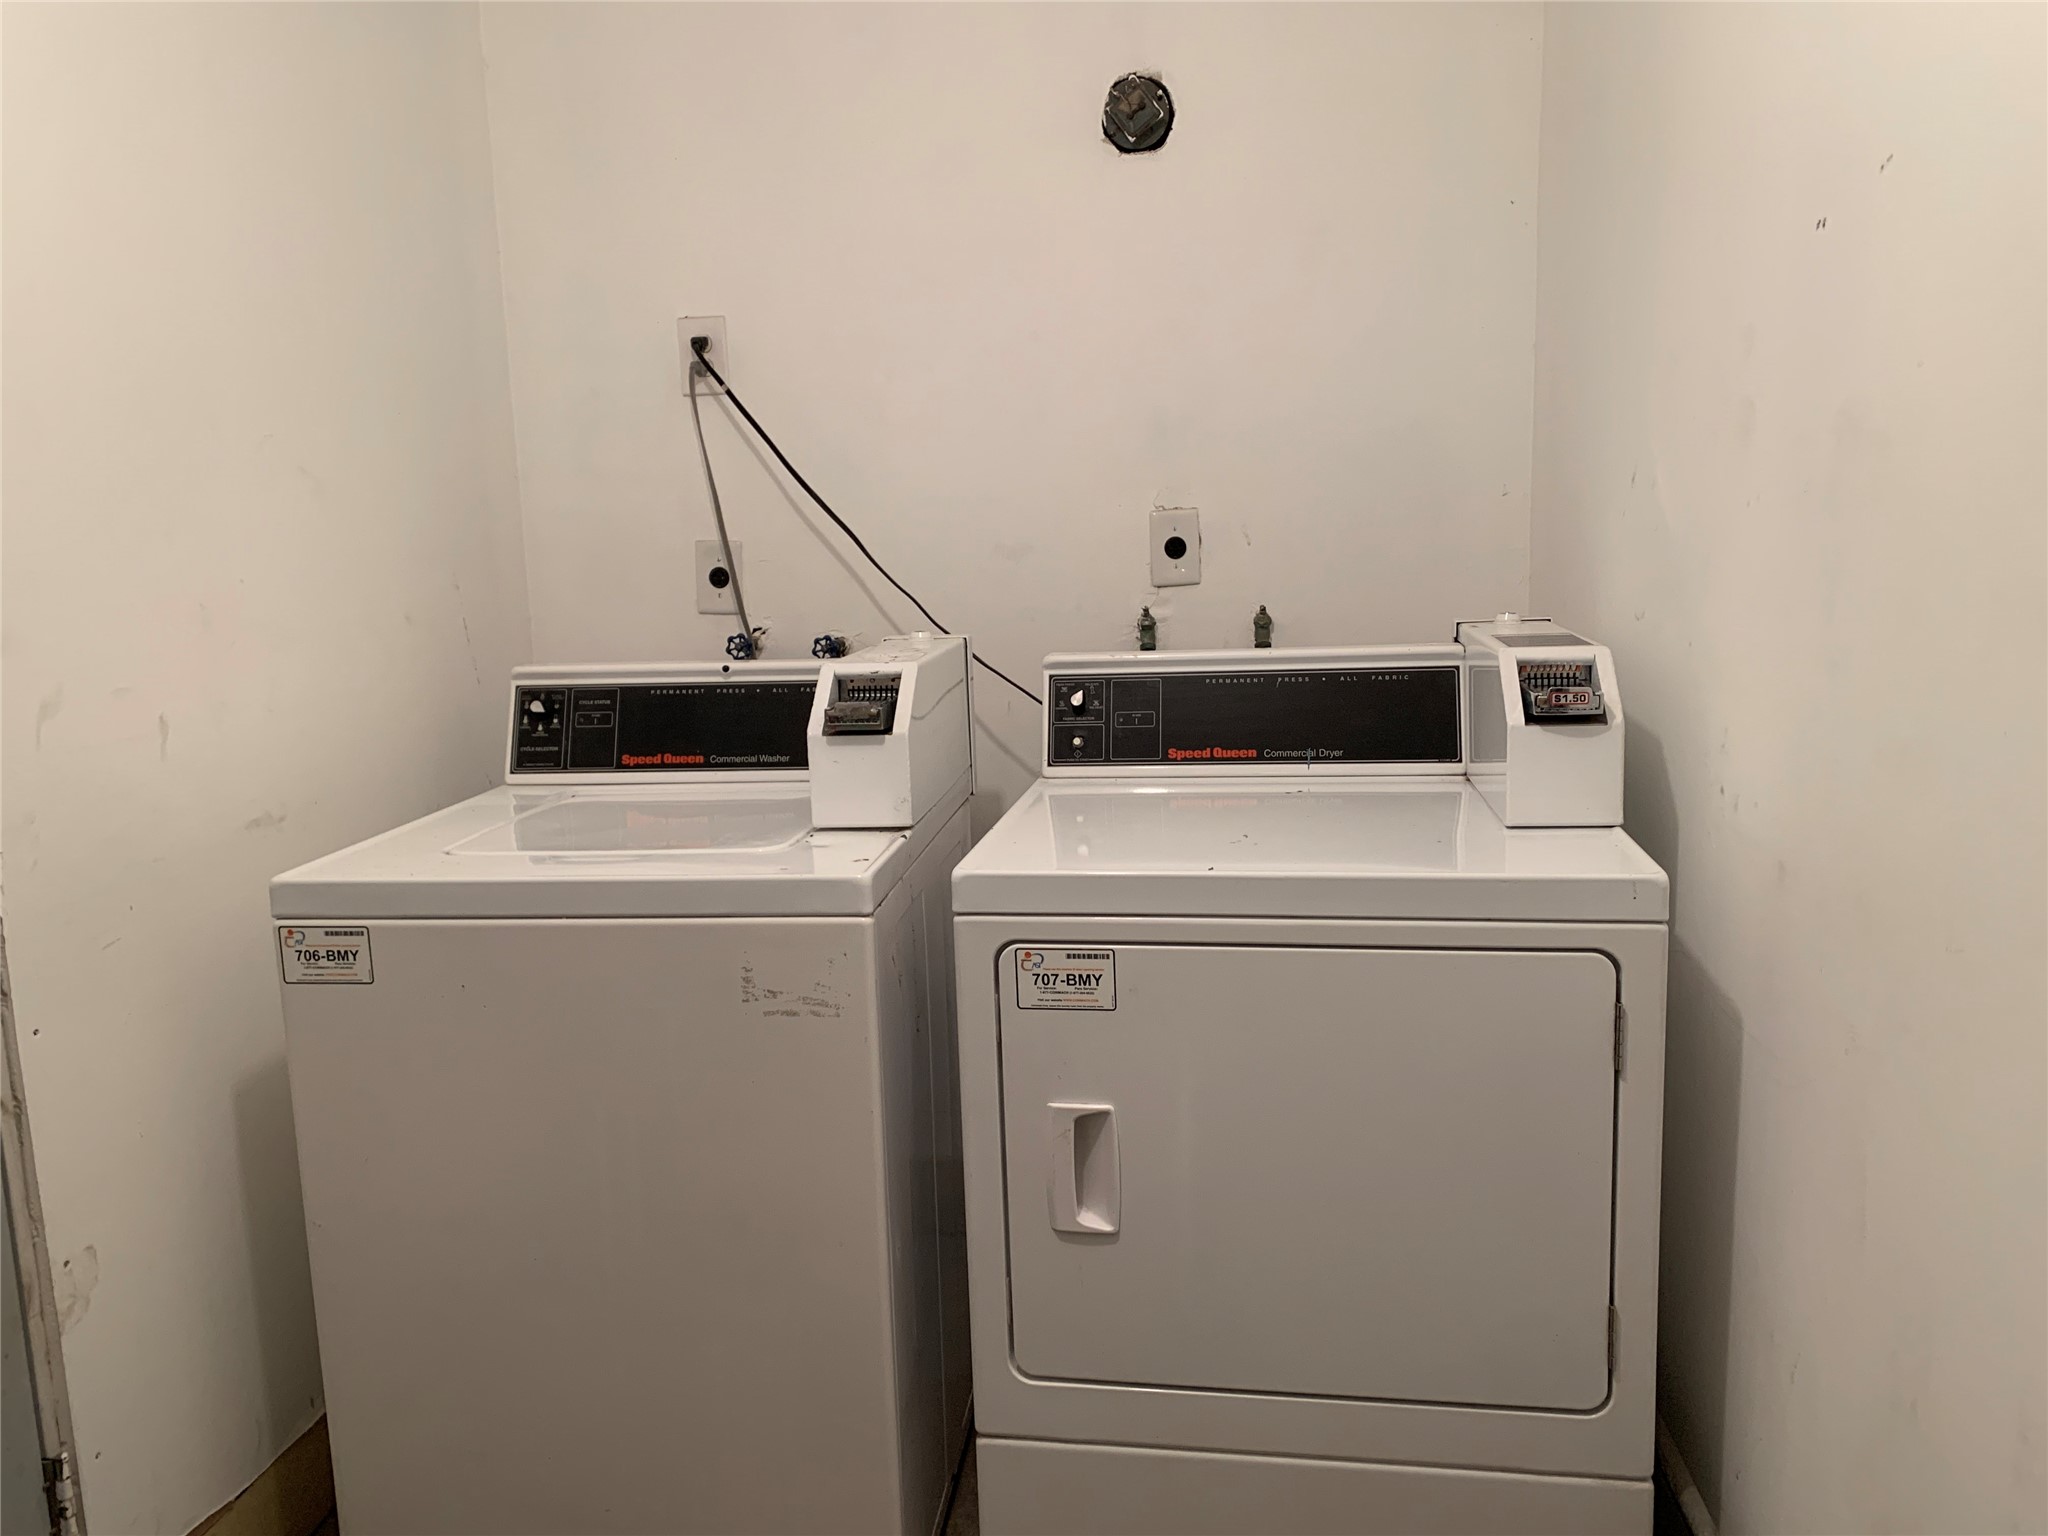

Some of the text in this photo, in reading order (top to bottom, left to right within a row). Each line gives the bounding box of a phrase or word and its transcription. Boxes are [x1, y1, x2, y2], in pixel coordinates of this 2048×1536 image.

[1554, 694, 1586, 703] $1.50
[621, 753, 790, 767] Speed Queen Commercial Washer
[1167, 747, 1344, 760] Speed Queen Commercial Dryer
[294, 949, 359, 962] 706-BMY
[1032, 973, 1103, 987] 707-BMY
